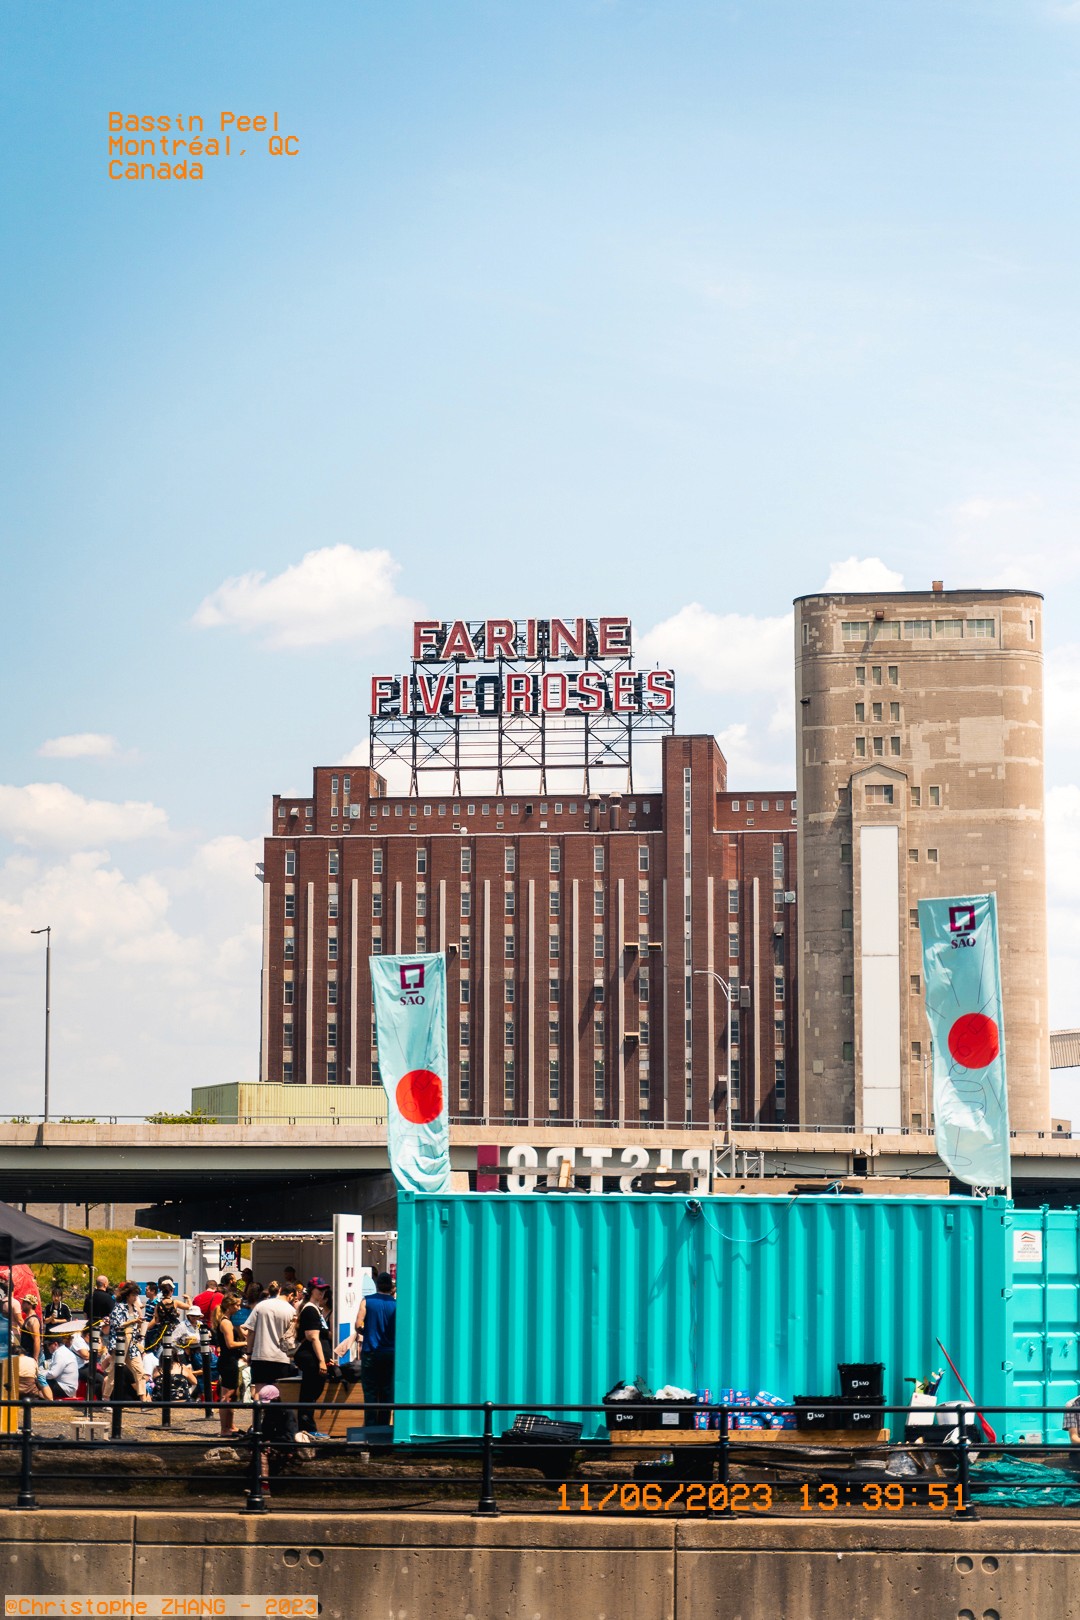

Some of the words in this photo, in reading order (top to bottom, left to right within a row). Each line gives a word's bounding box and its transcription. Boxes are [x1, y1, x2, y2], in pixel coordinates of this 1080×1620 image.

[412, 617, 631, 660] FARINE
[371, 674, 479, 715] FIVE
[506, 670, 675, 713] ROSES
[399, 995, 426, 1006] SAQ
